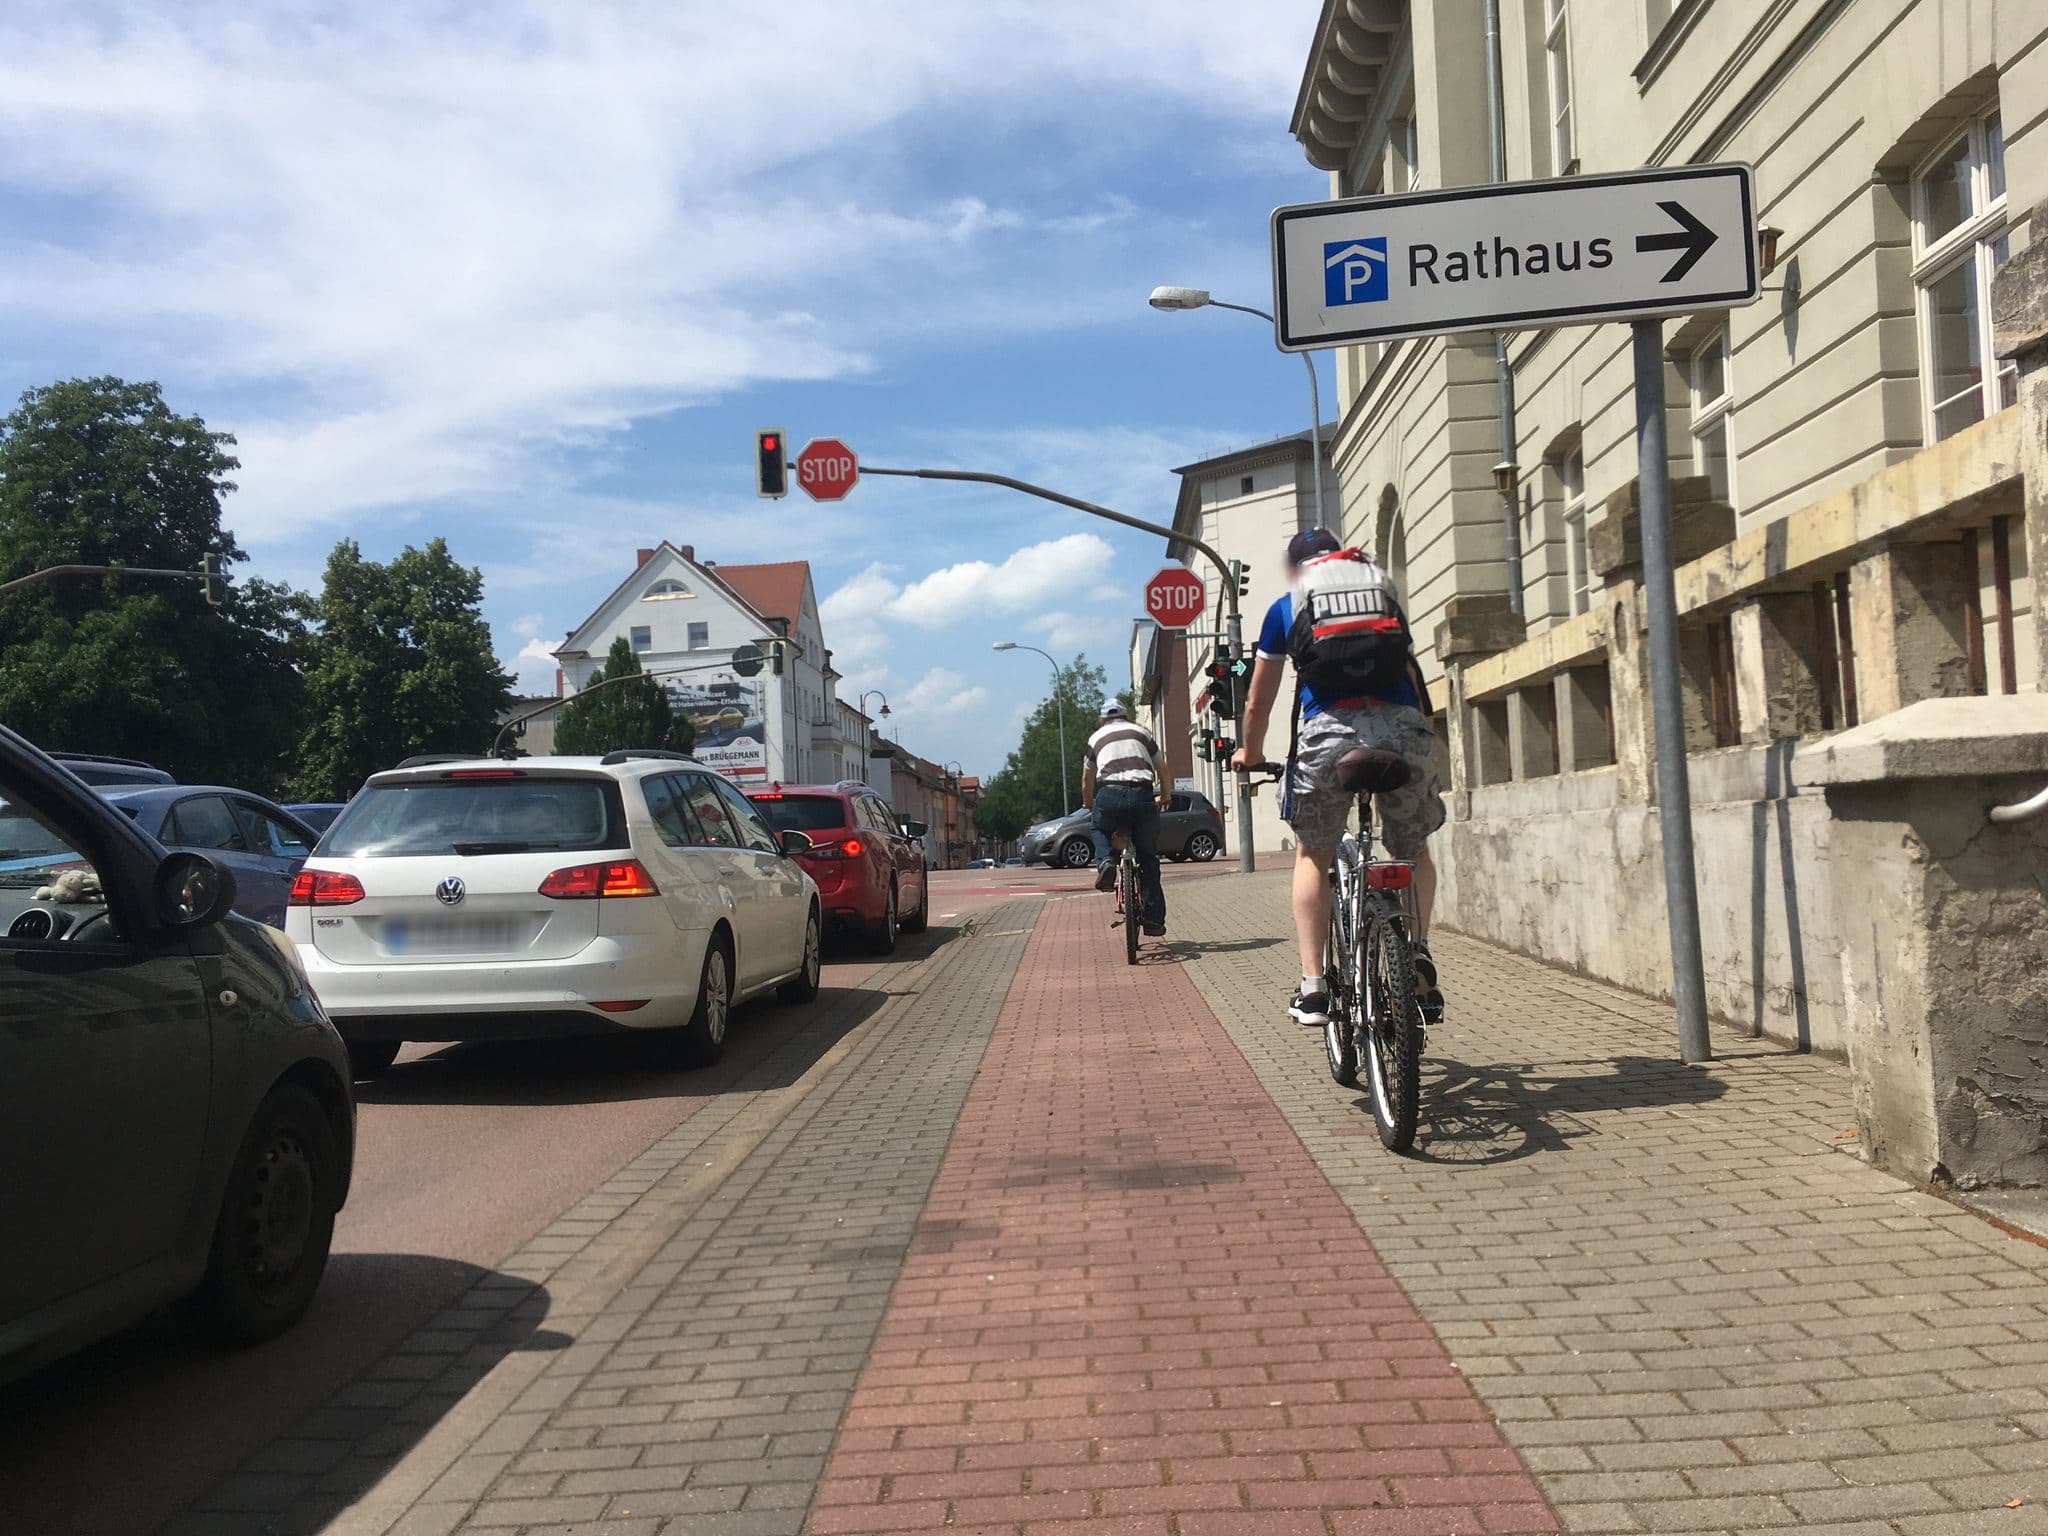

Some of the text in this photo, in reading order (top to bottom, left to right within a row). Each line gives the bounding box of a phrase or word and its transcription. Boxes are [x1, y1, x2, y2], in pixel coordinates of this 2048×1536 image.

[1344, 236, 1614, 302] P Rathaus
[802, 456, 852, 483] STOP
[1150, 585, 1200, 611] STOP
[709, 750, 760, 761] BRÜGGEMANN
